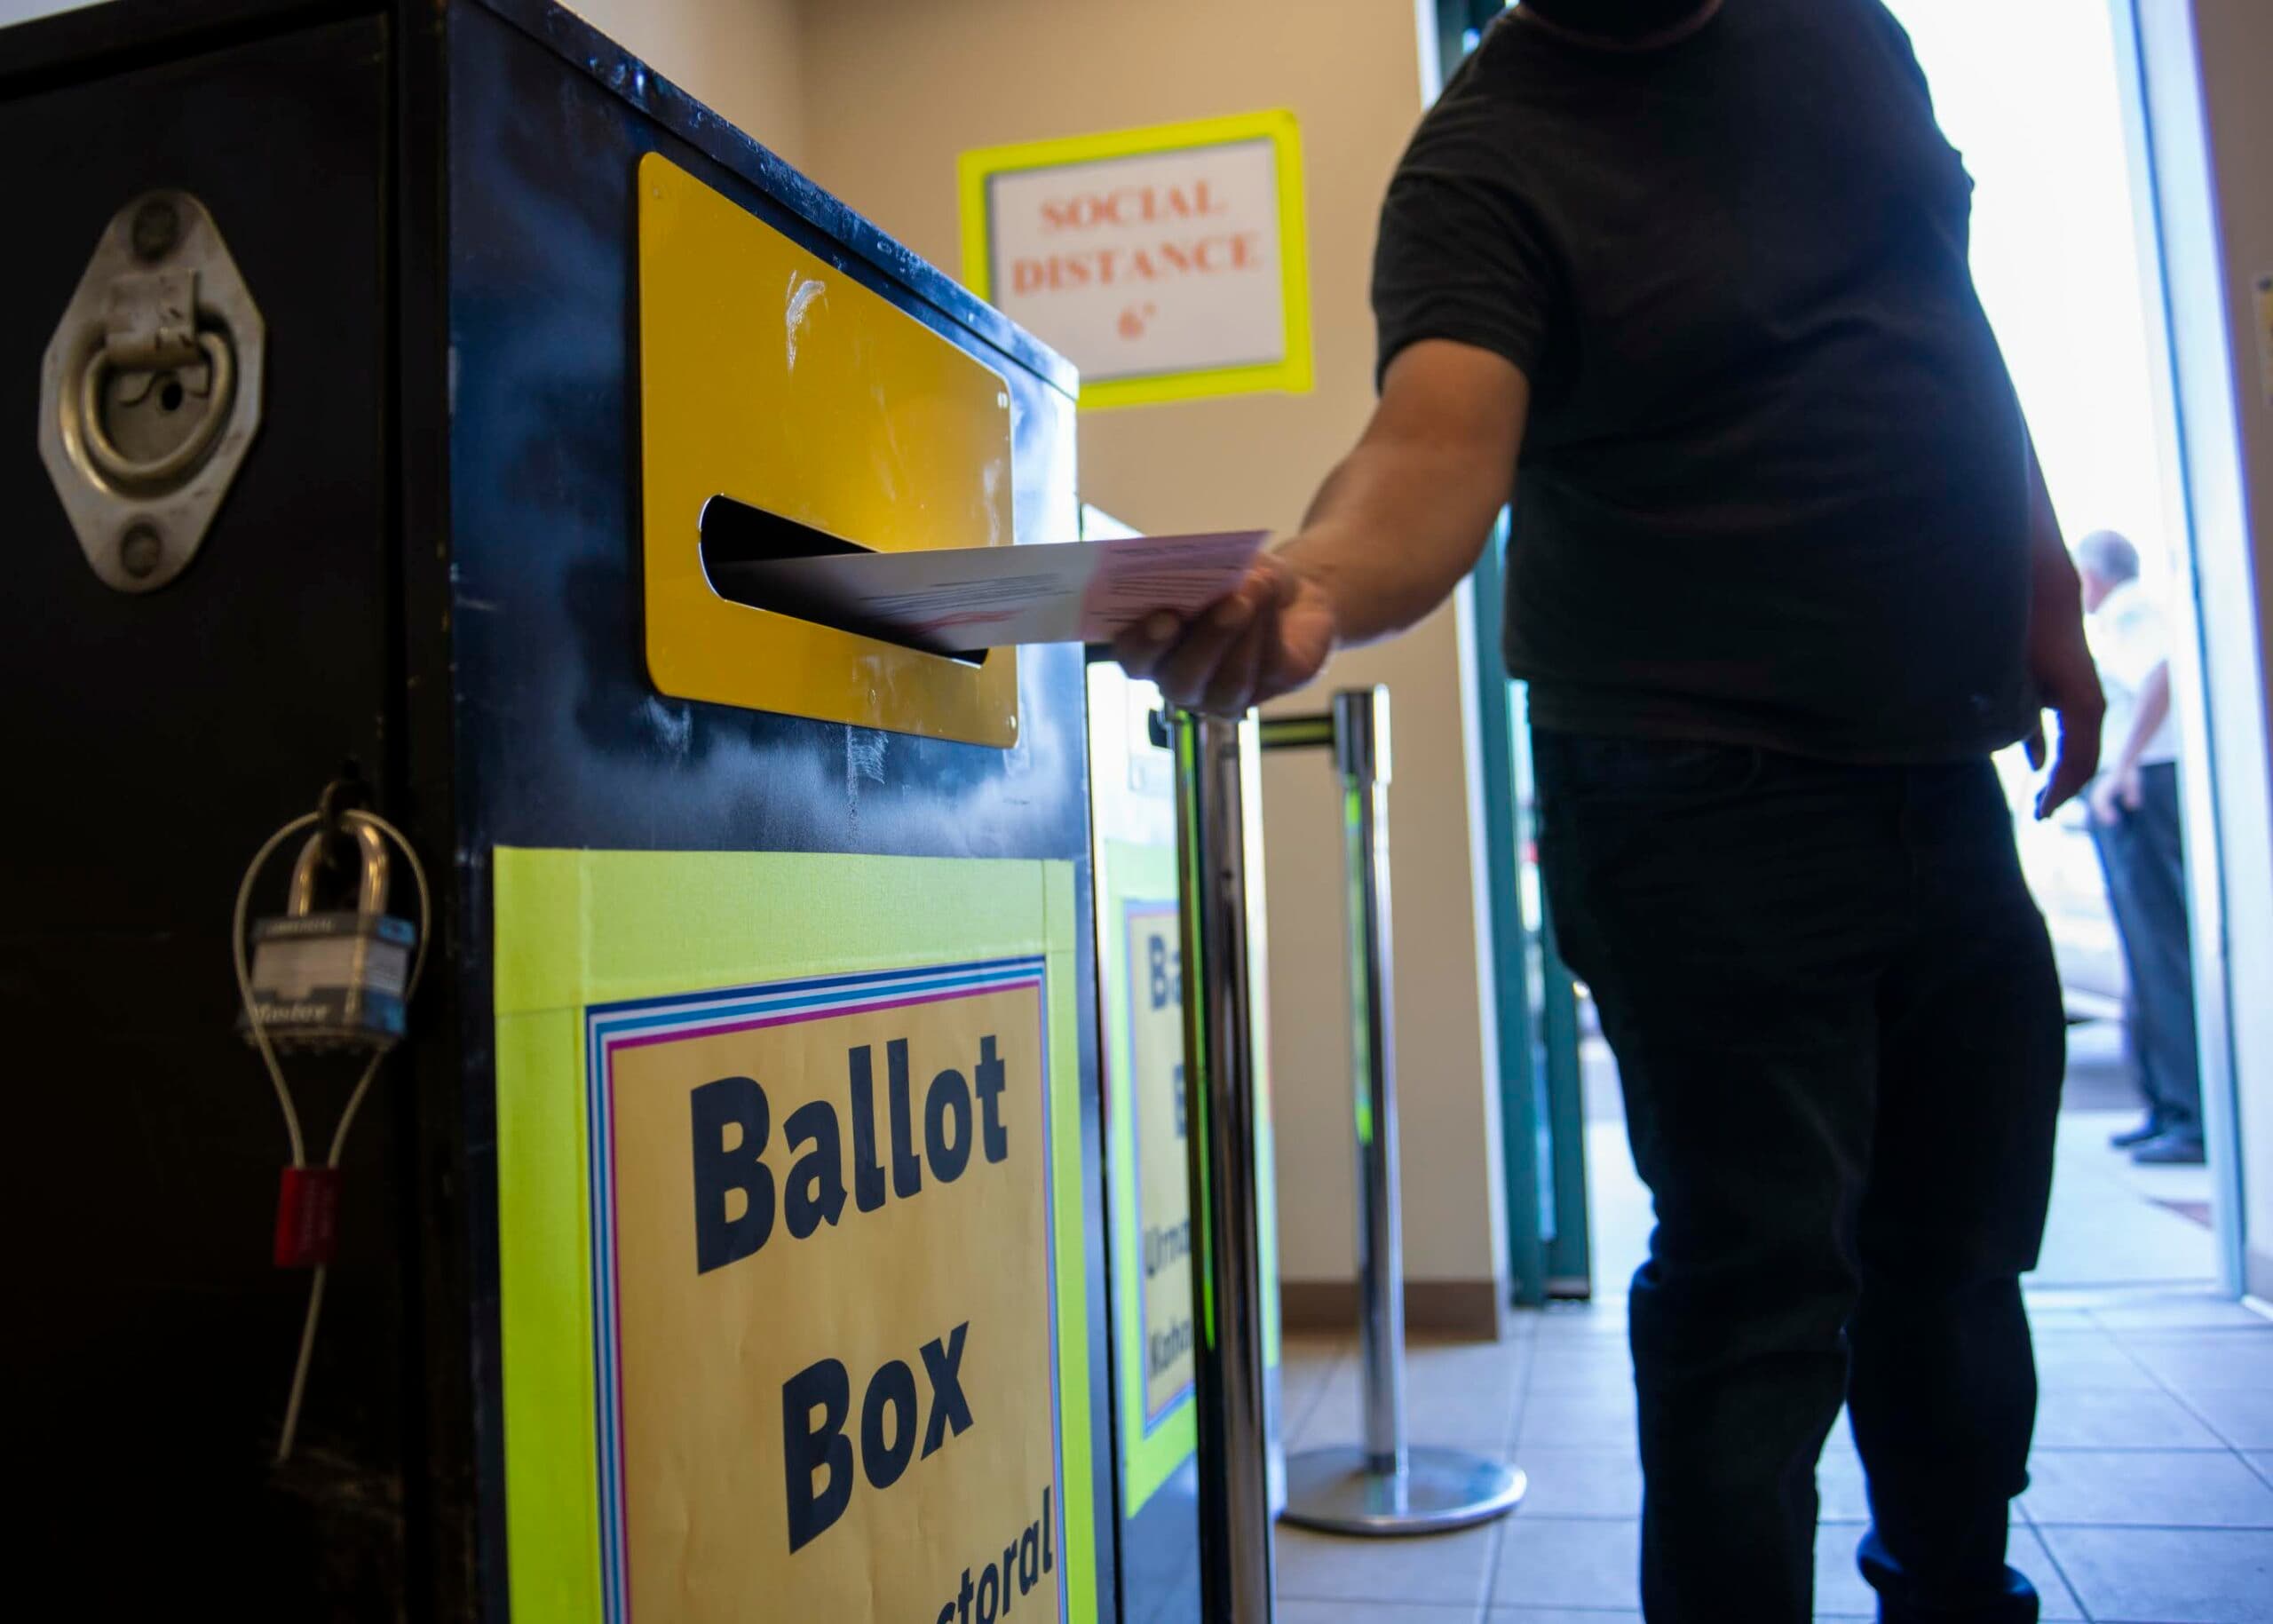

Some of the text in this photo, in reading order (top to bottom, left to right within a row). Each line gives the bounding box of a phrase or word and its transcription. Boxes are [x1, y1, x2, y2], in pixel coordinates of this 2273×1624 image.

[1012, 232, 1258, 296] DISTANCE
[1040, 179, 1226, 233] SOCIAL
[691, 1035, 1009, 1275] Ballot
[782, 1320, 974, 1556] Box
